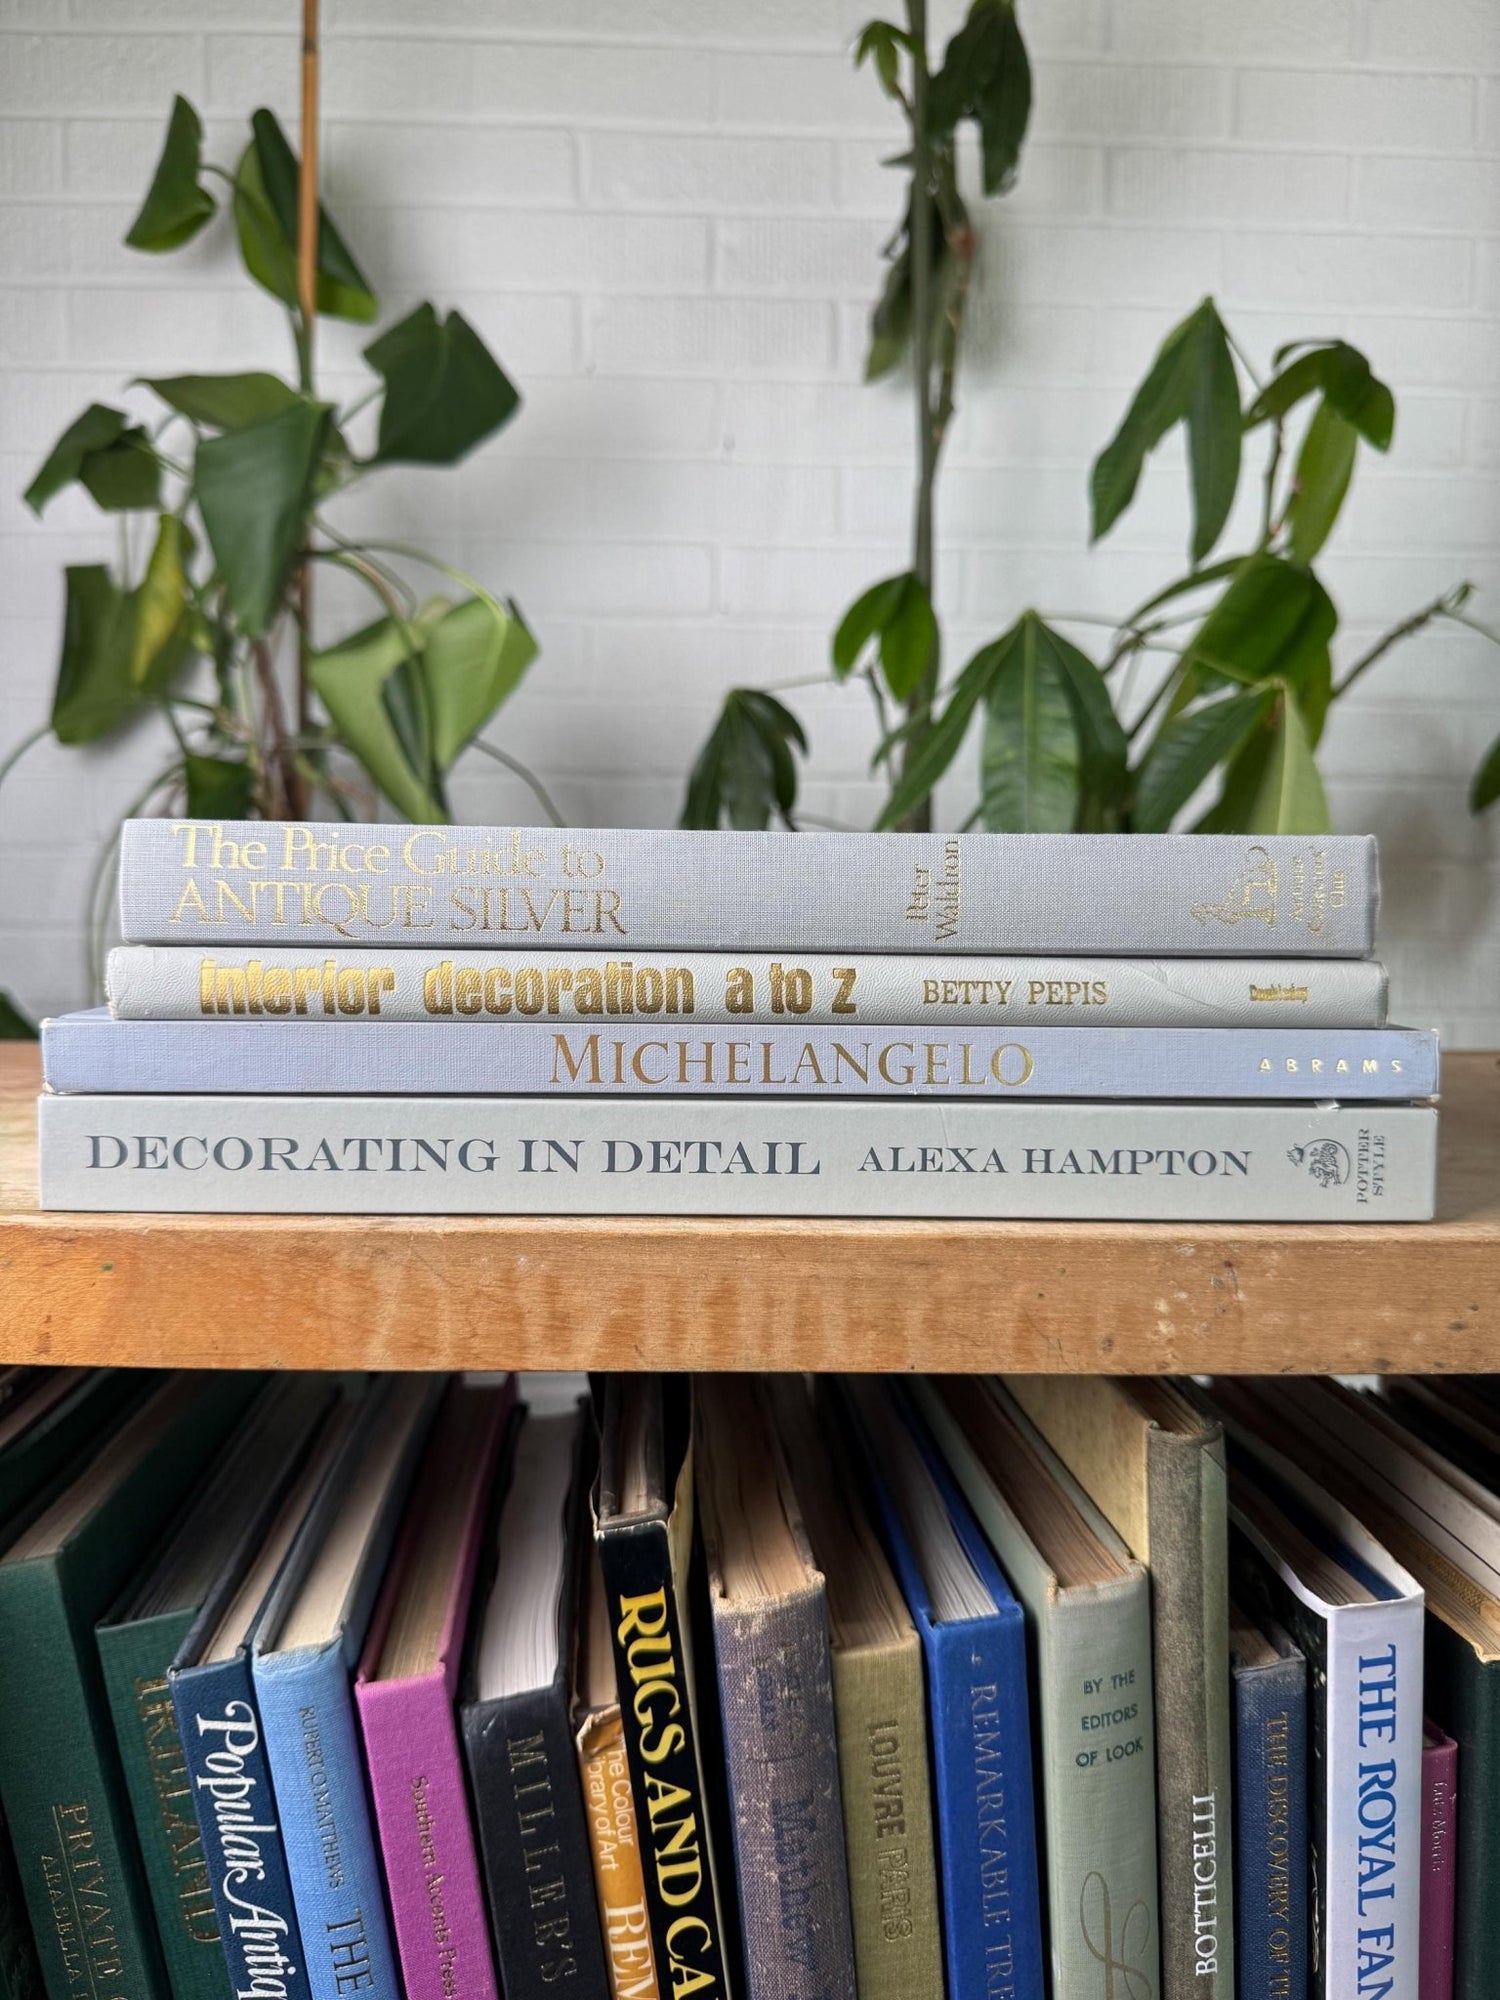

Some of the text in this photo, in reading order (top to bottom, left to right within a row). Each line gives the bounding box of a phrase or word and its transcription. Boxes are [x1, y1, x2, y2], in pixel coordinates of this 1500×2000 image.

[172, 823, 604, 879] The Price Guide to
[934, 838, 960, 943] Waldron
[169, 878, 630, 937] ANTIQUE SILVER
[905, 863, 931, 921] Peter
[200, 957, 397, 1016] interior
[422, 959, 695, 1016] decoration
[724, 965, 755, 1014] a
[770, 959, 811, 1013] to
[923, 979, 1109, 1007] BETTY PEPIS
[549, 1032, 1035, 1088] MICHELANGELO
[1258, 1056, 1403, 1074] ABRAMS
[87, 1133, 821, 1177] DECORATING IN DETAIL
[857, 1145, 1254, 1178] ALEXA HAMPTON
[1356, 1128, 1370, 1203] POTTER
[1371, 1135, 1386, 1197] STYLE
[617, 1586, 687, 1764] RUGS
[1083, 1669, 1136, 1696] BY THE
[1358, 1644, 1396, 1748] THE
[299, 1705, 325, 1769] RUPERT
[1075, 1739, 1144, 1768] OF LOOK
[1081, 1705, 1138, 1732] EDITORS
[1265, 1711, 1290, 1768] THE
[196, 1700, 277, 1882] Popular
[586, 1755, 619, 1871] ibrary of Art
[607, 1749, 635, 1846] he Colour
[868, 1719, 914, 1942] LOUVRE PARIS
[970, 1681, 1011, 1928] REMARKABLE
[507, 1729, 578, 1984] MILLER'S
[644, 1771, 703, 1906] AND
[1266, 1775, 1290, 1922] DISCOVERY
[1357, 1759, 1397, 1917] ROYAL
[41, 1854, 83, 1983] ARABELLA
[60, 1799, 123, 1979] PRIVATE
[410, 1775, 460, 2000] Southern Accents Press
[1192, 1792, 1219, 1976] BOTTICELLI
[326, 1907, 375, 1995] THE
[1267, 1927, 1290, 1964] OF
